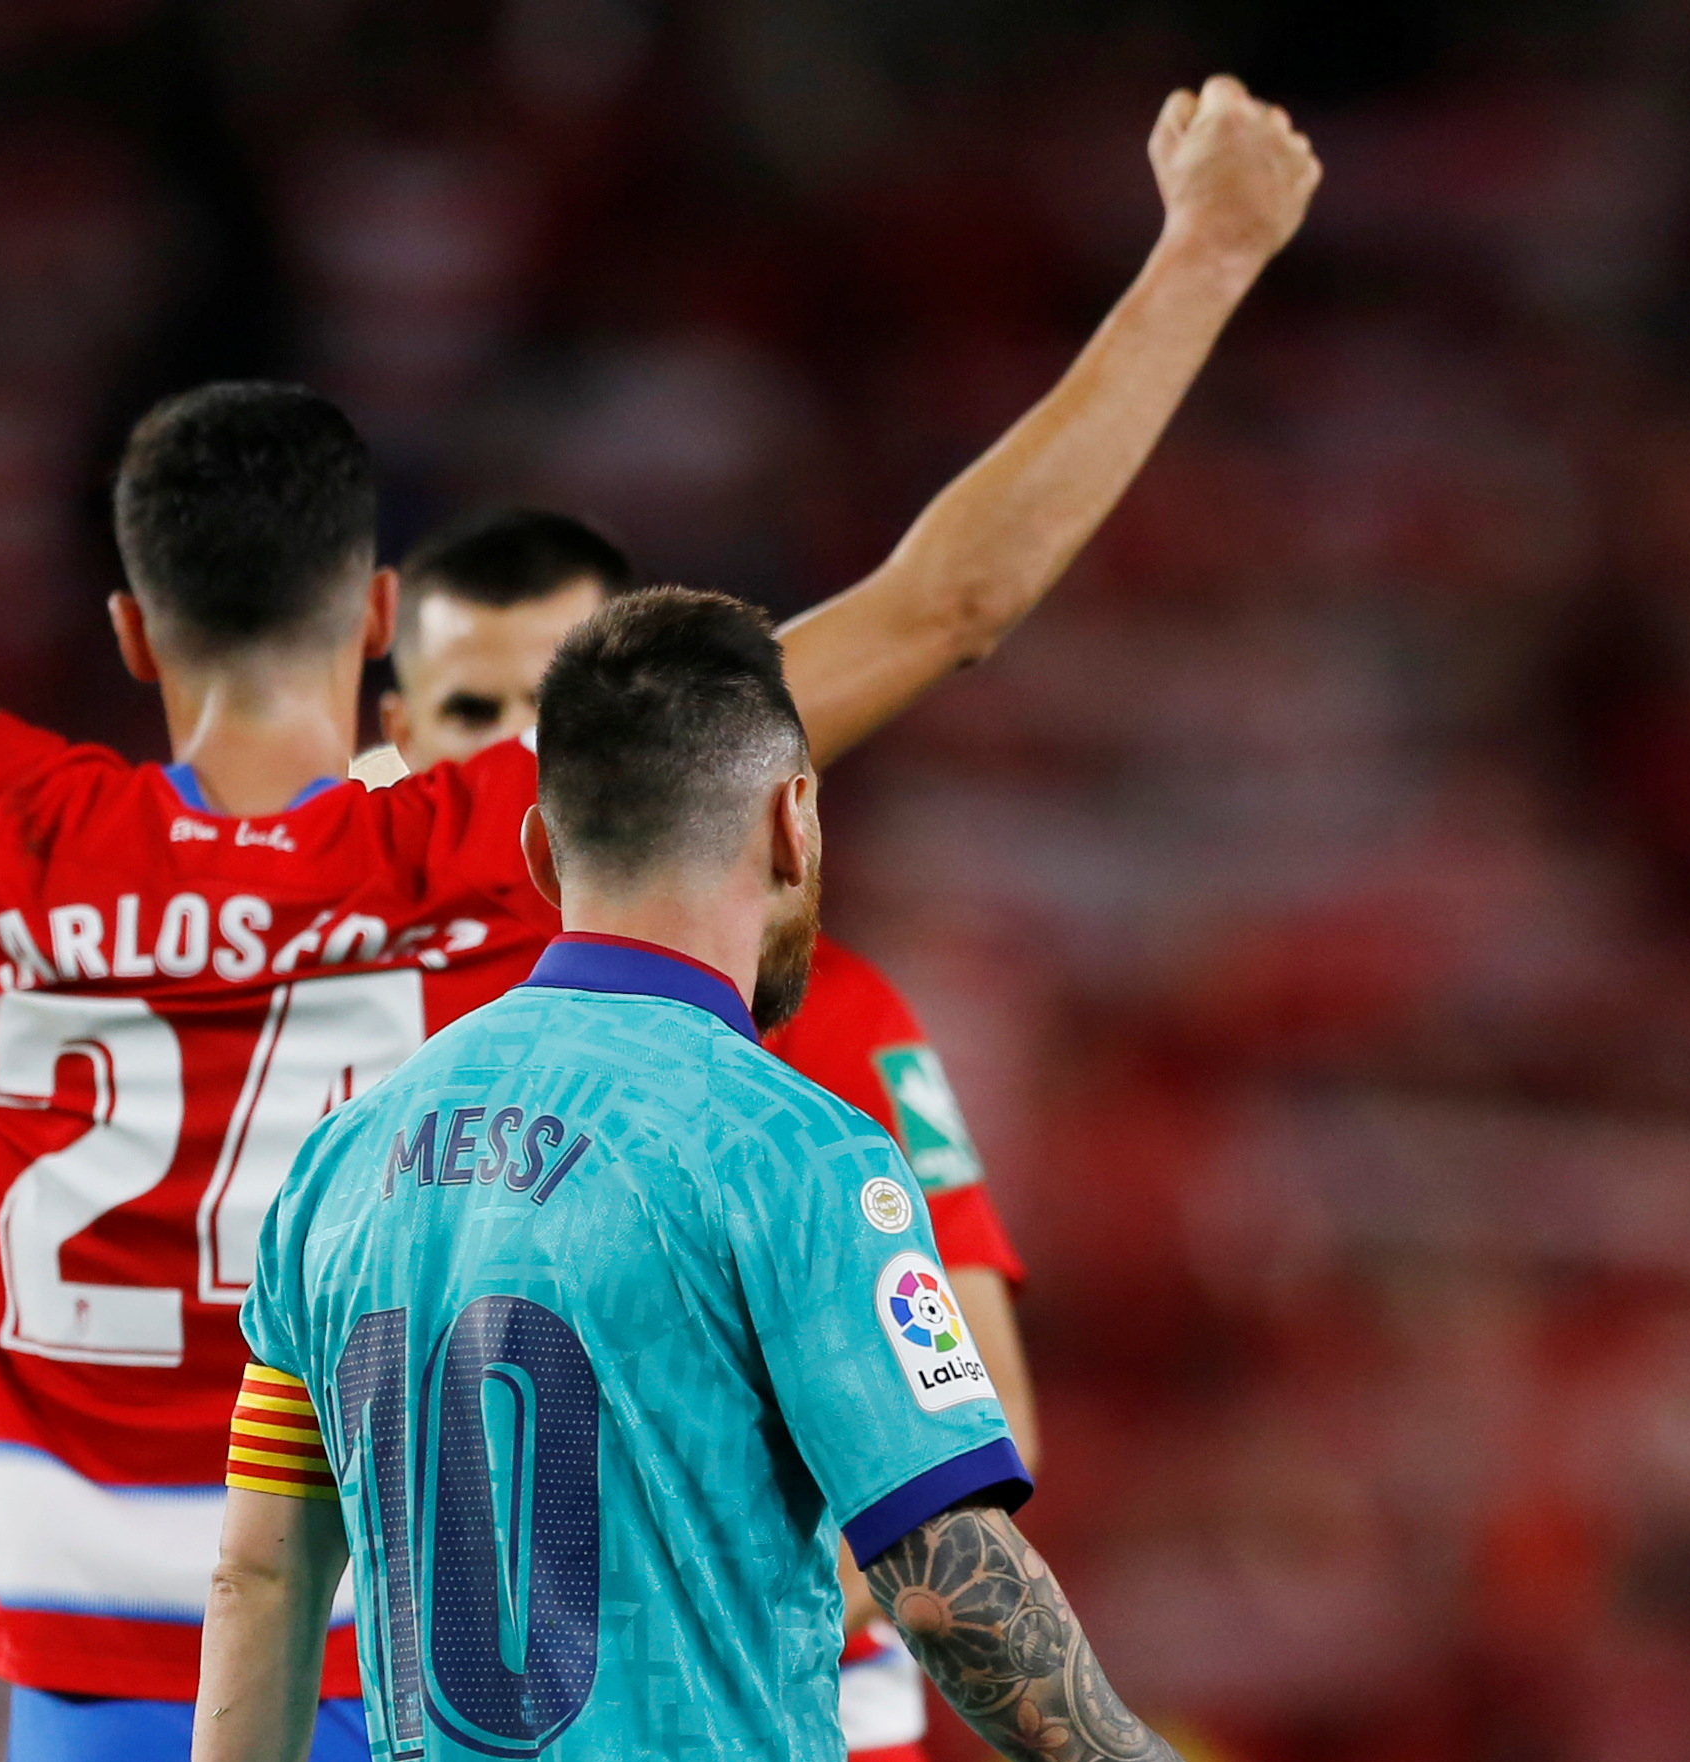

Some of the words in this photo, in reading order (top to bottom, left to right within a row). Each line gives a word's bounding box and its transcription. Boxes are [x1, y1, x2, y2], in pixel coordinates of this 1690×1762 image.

[381, 1106, 592, 1207] MESSI
[917, 1355, 985, 1390] LaLiga
[323, 1294, 600, 1762] 10
